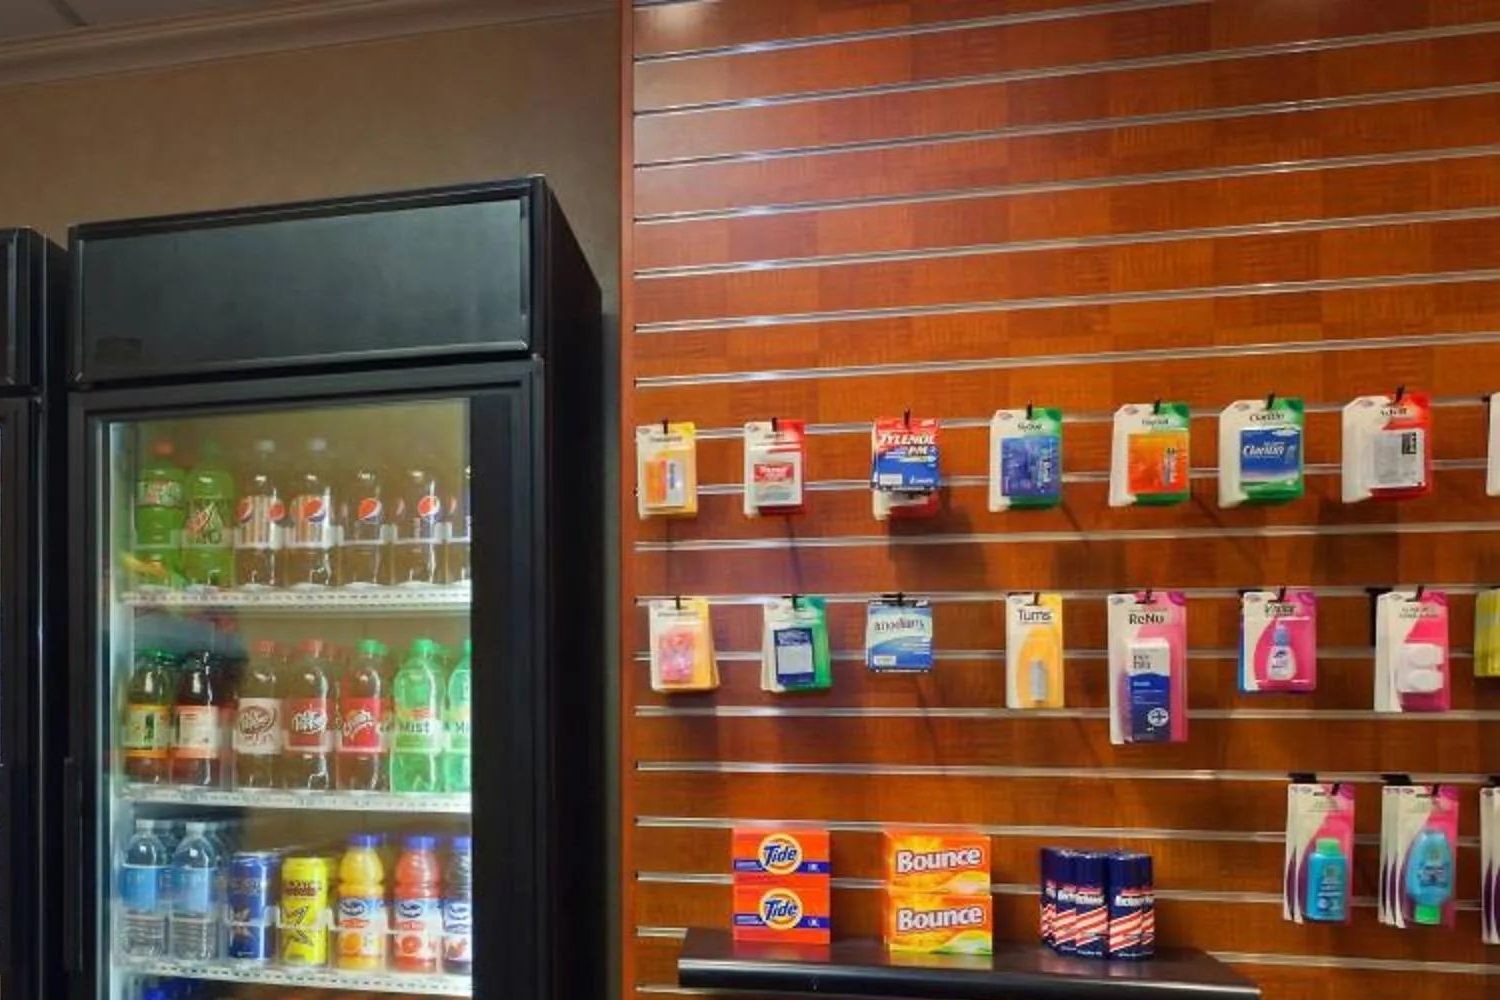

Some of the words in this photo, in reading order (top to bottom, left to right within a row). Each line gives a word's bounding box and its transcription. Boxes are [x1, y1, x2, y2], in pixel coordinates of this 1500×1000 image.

[1017, 608, 1052, 622] Tums
[763, 843, 798, 866] Tide
[895, 847, 983, 874] Bounce
[764, 898, 799, 921] Tide
[897, 906, 984, 932] Bounce
